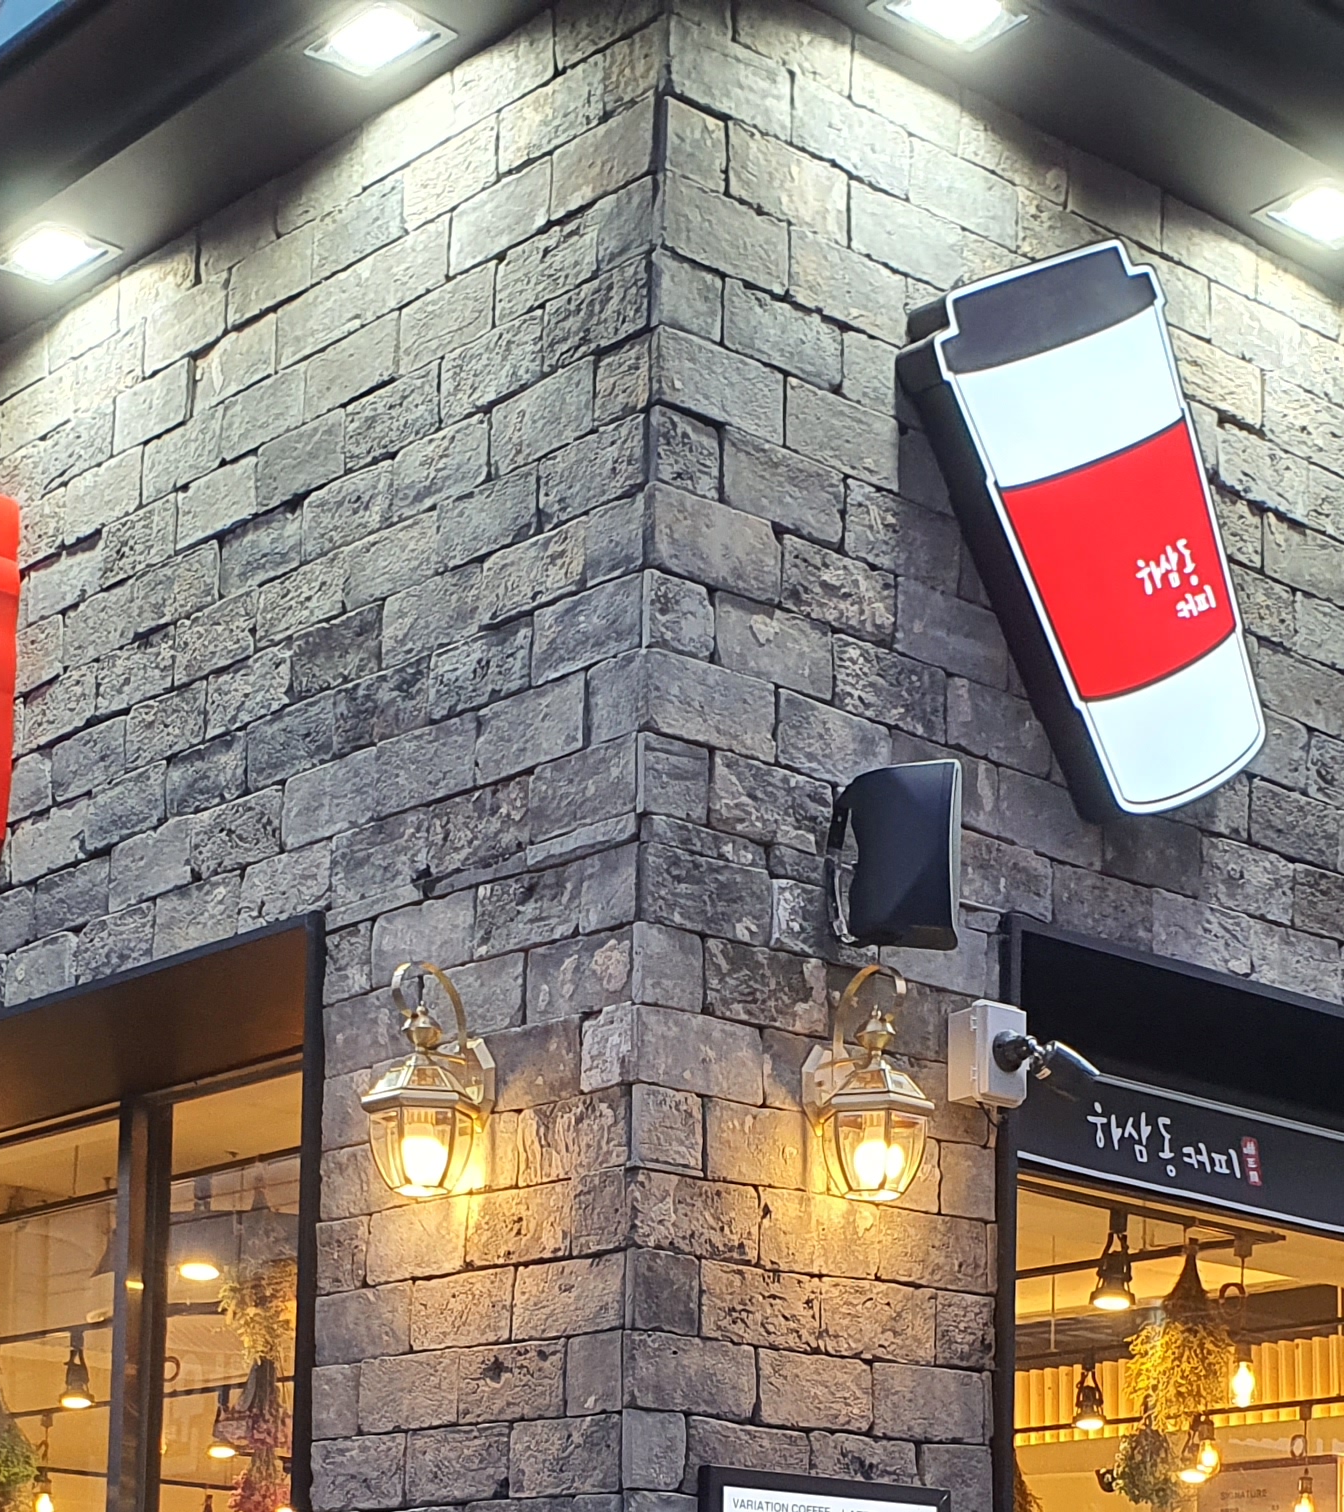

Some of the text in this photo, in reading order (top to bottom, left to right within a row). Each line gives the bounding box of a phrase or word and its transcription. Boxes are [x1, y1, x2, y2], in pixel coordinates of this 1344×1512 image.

[1135, 538, 1200, 595] 하삼동
[1175, 584, 1218, 619] 커피
[1087, 1102, 1242, 1179] 하삼동 커피
[733, 1498, 789, 1512] VARIATION
[1220, 1488, 1268, 1500] SIGNATURE
